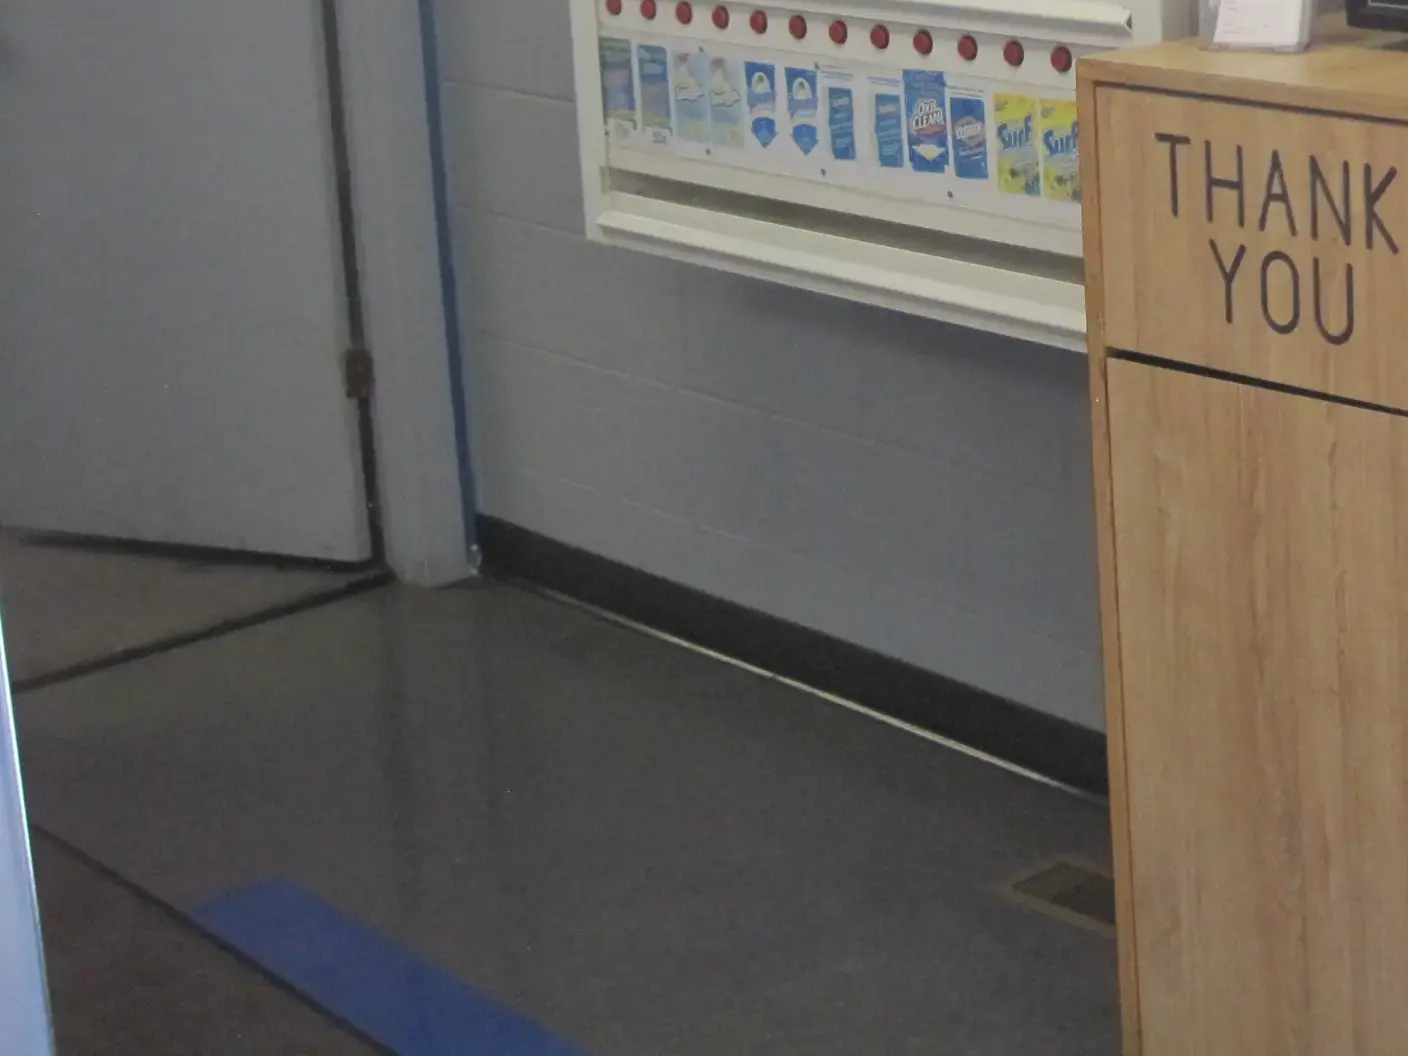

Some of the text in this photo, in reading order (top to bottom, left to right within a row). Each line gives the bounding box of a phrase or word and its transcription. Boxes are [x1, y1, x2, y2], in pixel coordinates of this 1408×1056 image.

[997, 114, 1033, 150] Surf
[1155, 132, 1399, 256] THANK
[1208, 238, 1355, 346] YOU
